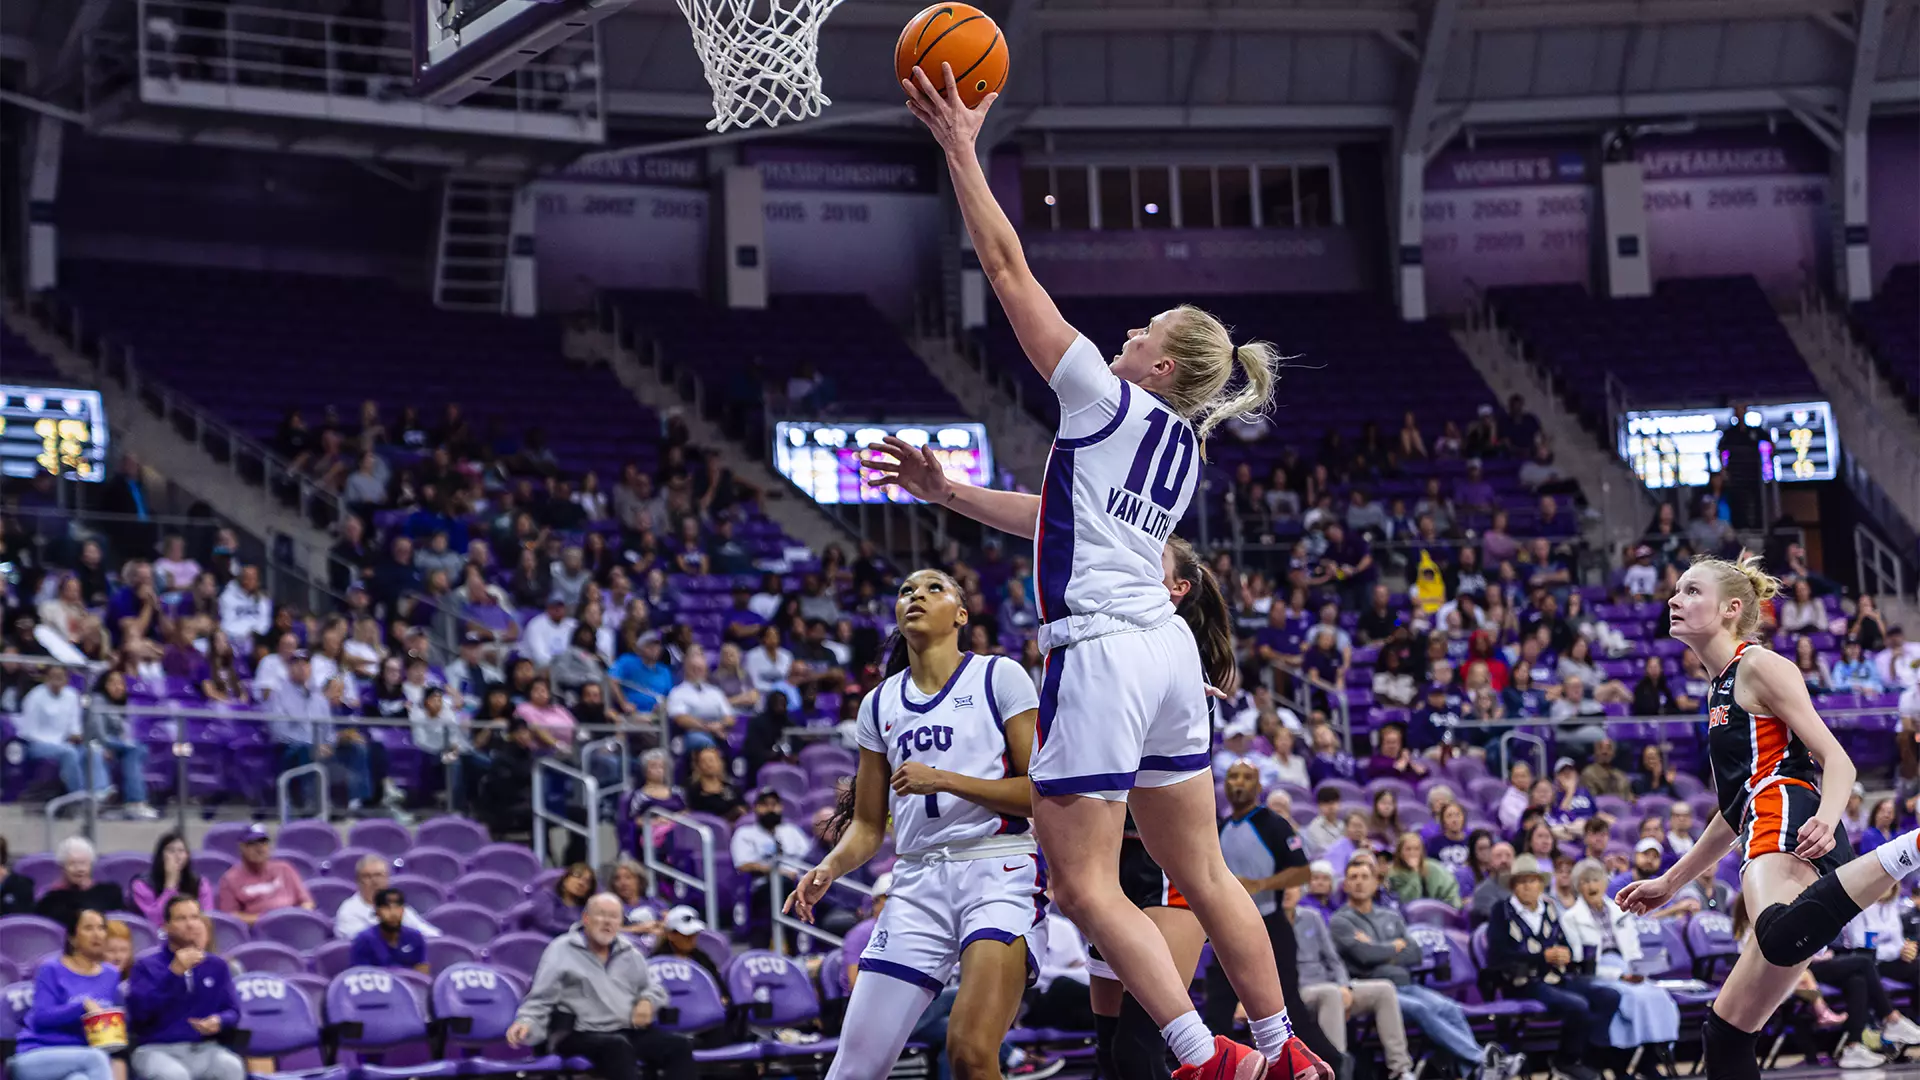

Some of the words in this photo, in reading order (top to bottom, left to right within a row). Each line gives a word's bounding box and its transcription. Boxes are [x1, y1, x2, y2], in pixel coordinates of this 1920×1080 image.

[1453, 158, 1551, 182] WOMEN'S
[1643, 150, 1787, 173] APPEARANCES
[1123, 407, 1194, 512] 10
[1106, 486, 1143, 526] VAN
[1141, 504, 1173, 542] LITH
[897, 725, 954, 761] TCU
[649, 962, 692, 982] TCU
[744, 956, 788, 977] TCU
[236, 978, 285, 1001] TCU
[344, 972, 392, 996] TCU
[450, 969, 498, 991] TCU
[7, 990, 34, 1012] TC
